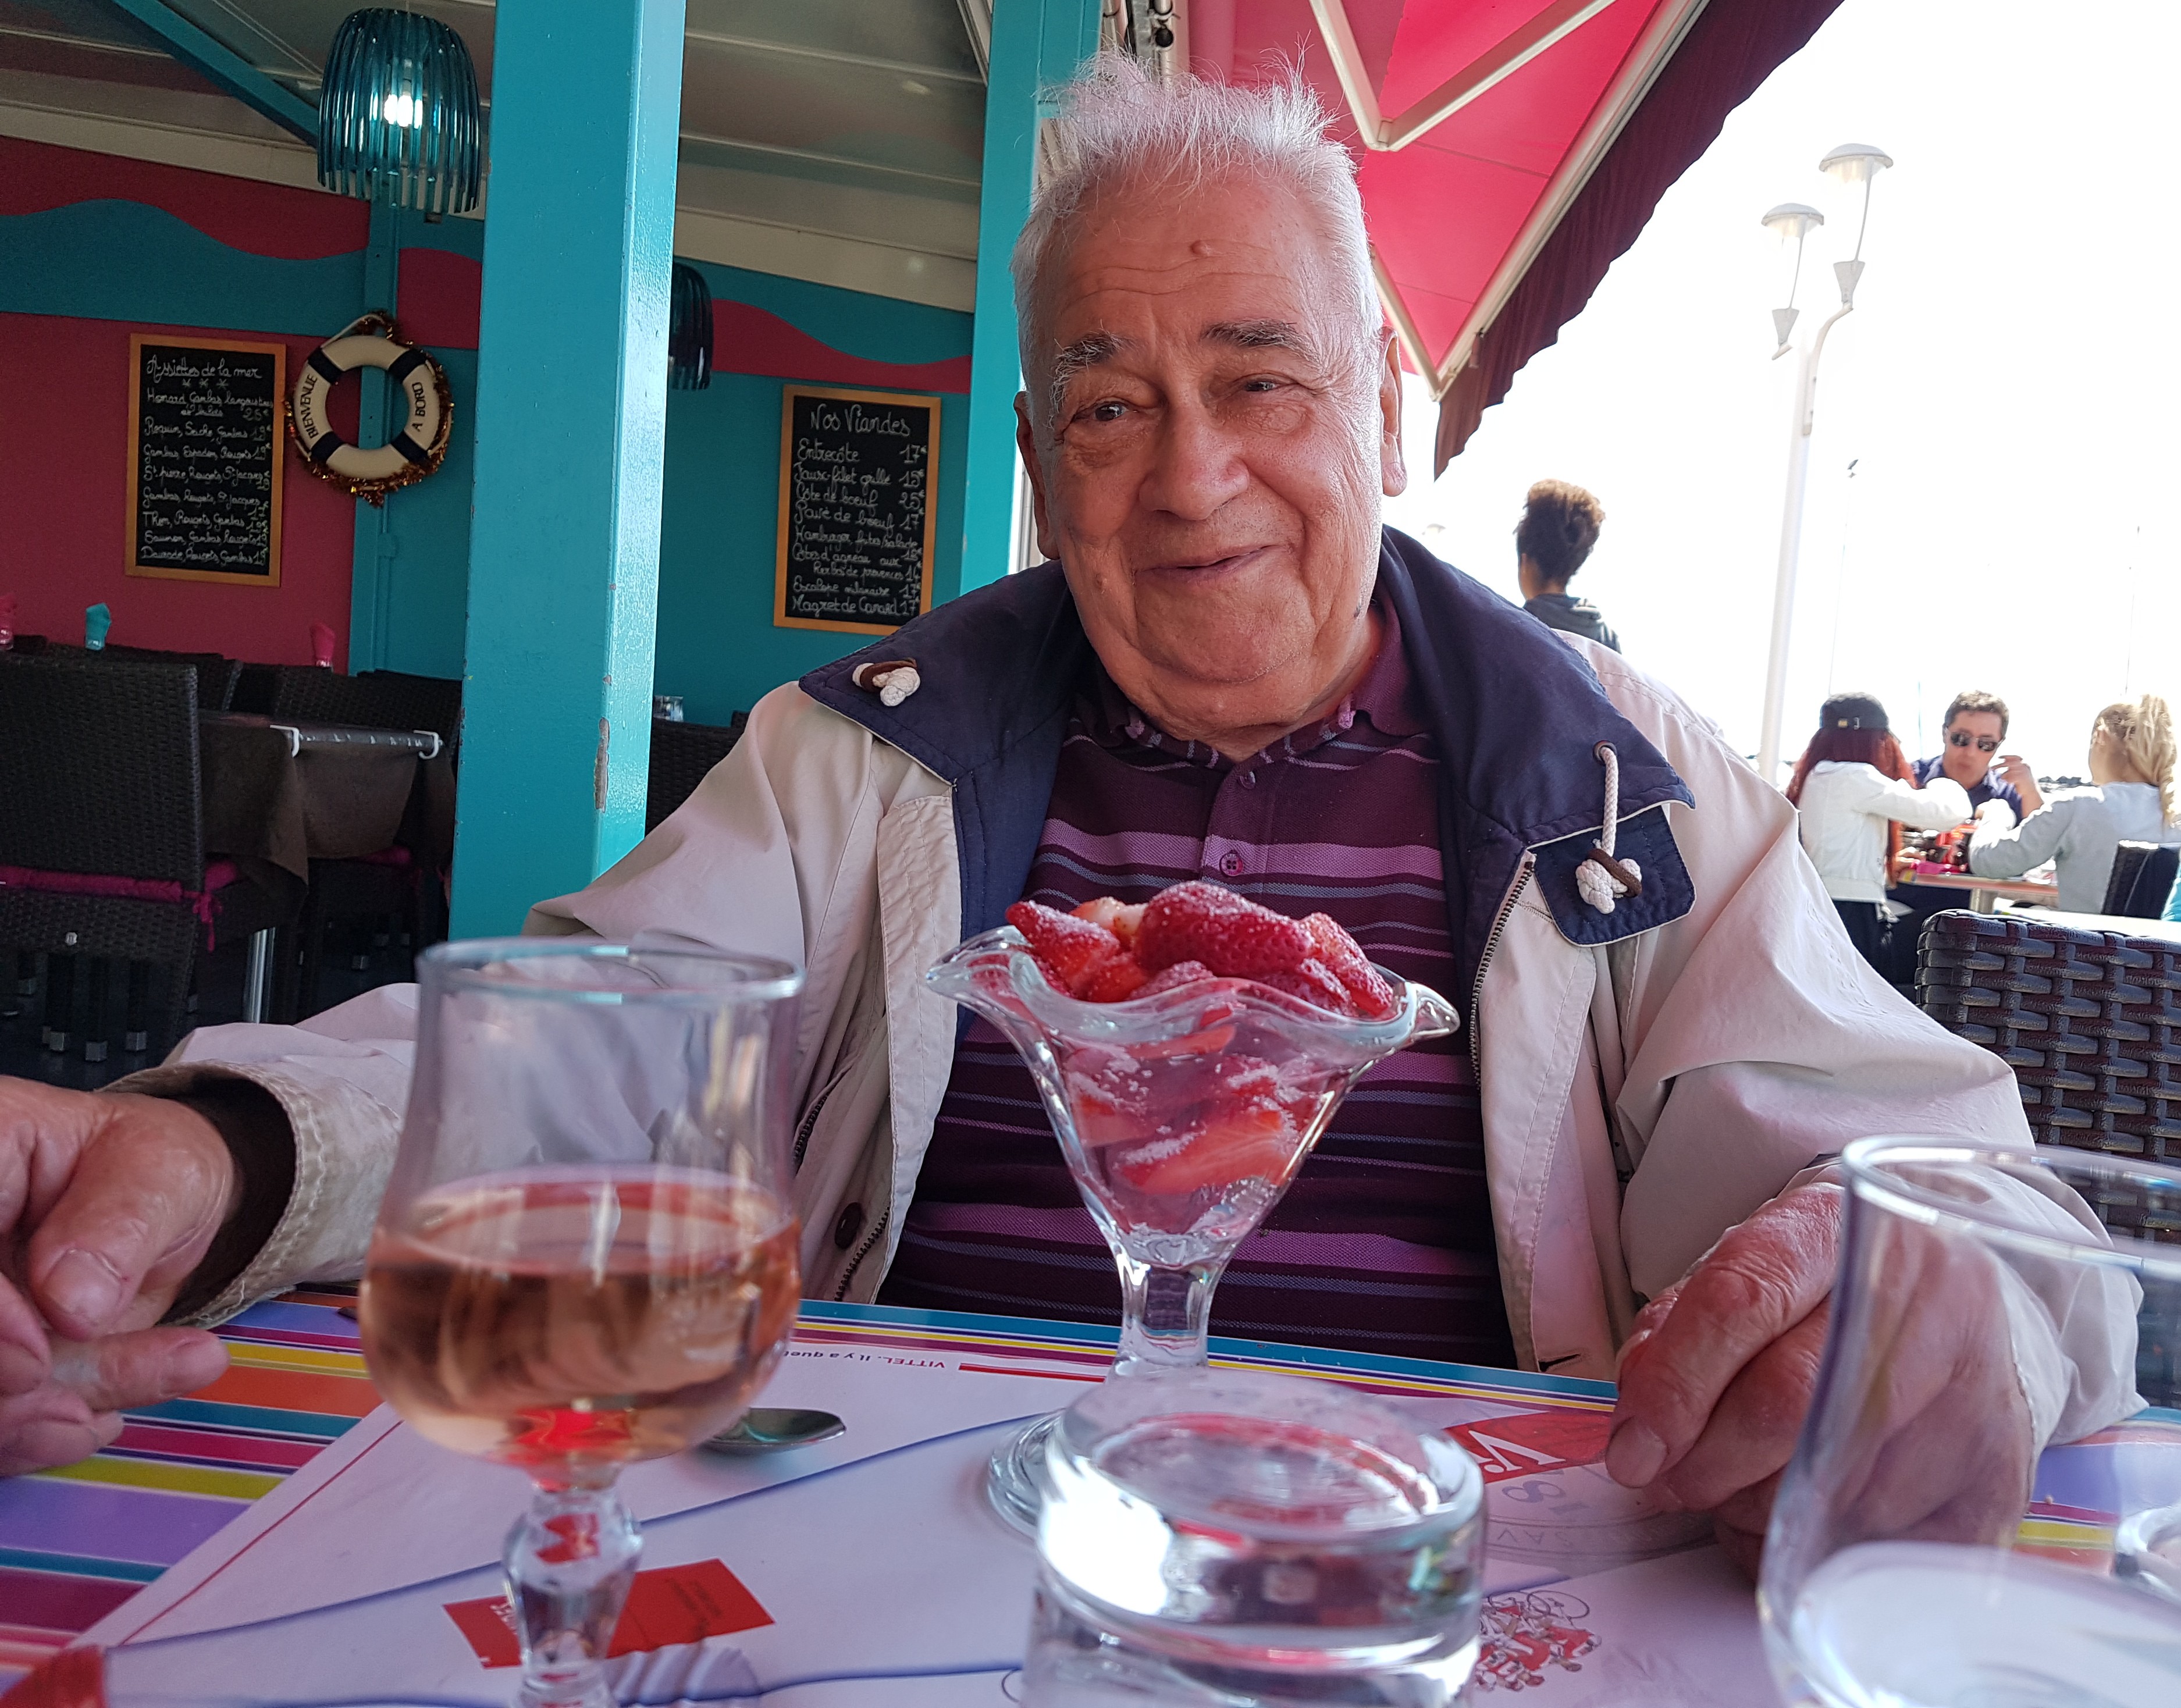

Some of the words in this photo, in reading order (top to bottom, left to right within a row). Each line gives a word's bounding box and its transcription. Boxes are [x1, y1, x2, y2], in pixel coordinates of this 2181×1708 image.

[299, 374, 319, 439] BIENVENUE
[412, 382, 426, 417] BORD
[811, 404, 841, 430] Nos
[844, 404, 911, 437] Viandes
[797, 437, 860, 463] Entrecôte
[834, 507, 852, 523] de
